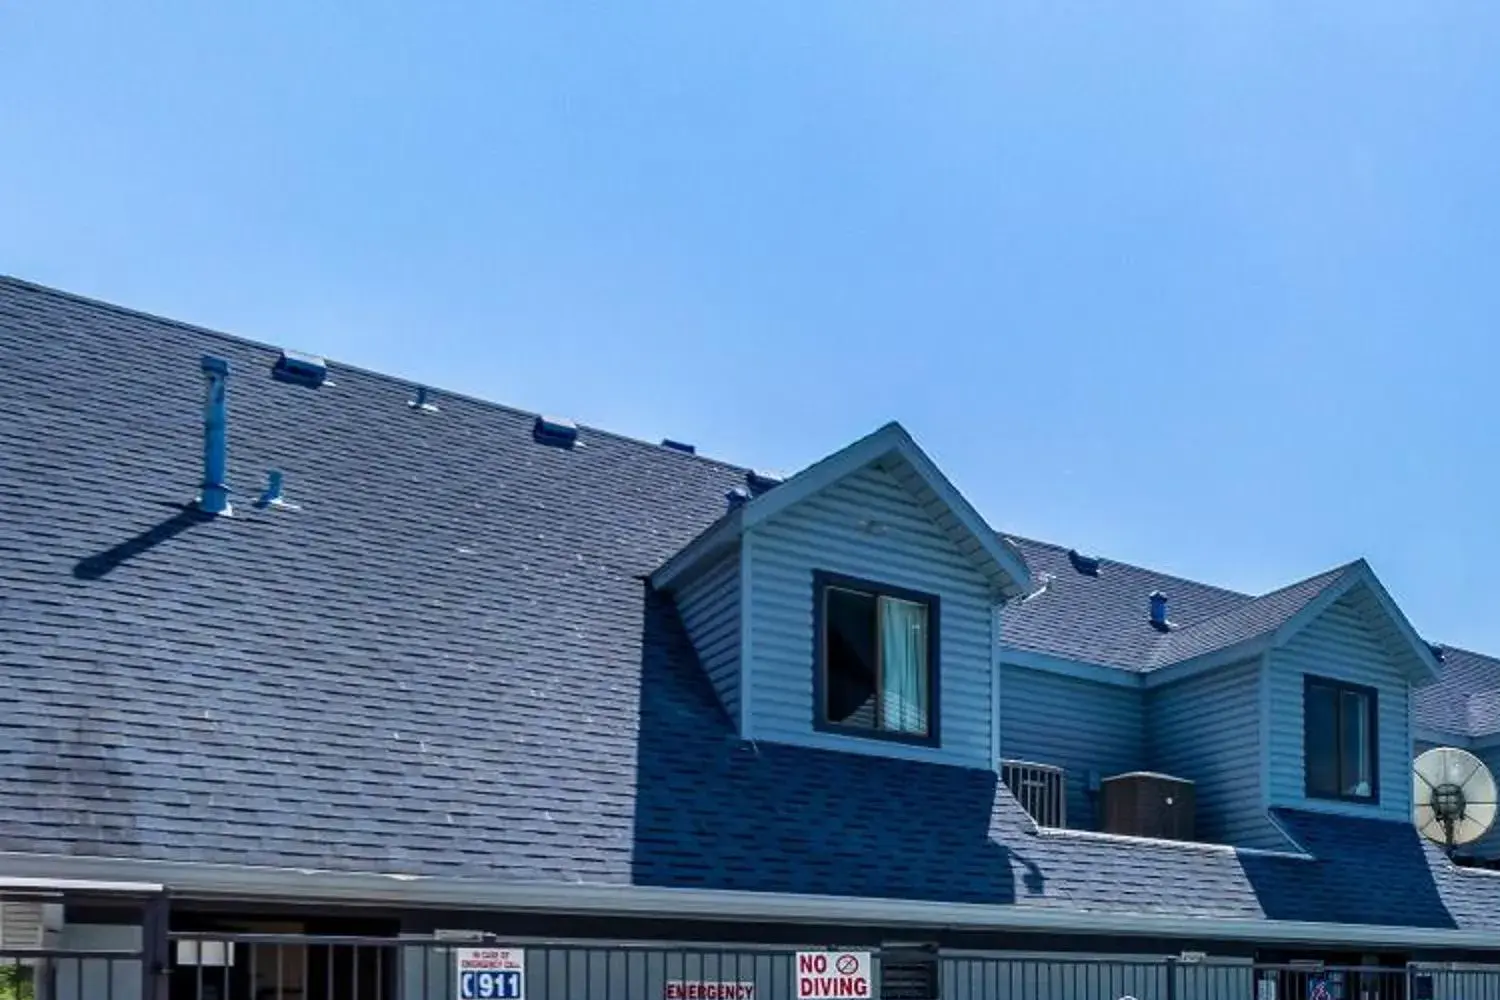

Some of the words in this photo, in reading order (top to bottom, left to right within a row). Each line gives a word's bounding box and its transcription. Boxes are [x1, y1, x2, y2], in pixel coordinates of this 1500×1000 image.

[800, 954, 827, 974] NO
[479, 973, 519, 997] 911
[666, 983, 753, 1000] EMERGENCY
[801, 977, 867, 996] DIVING
